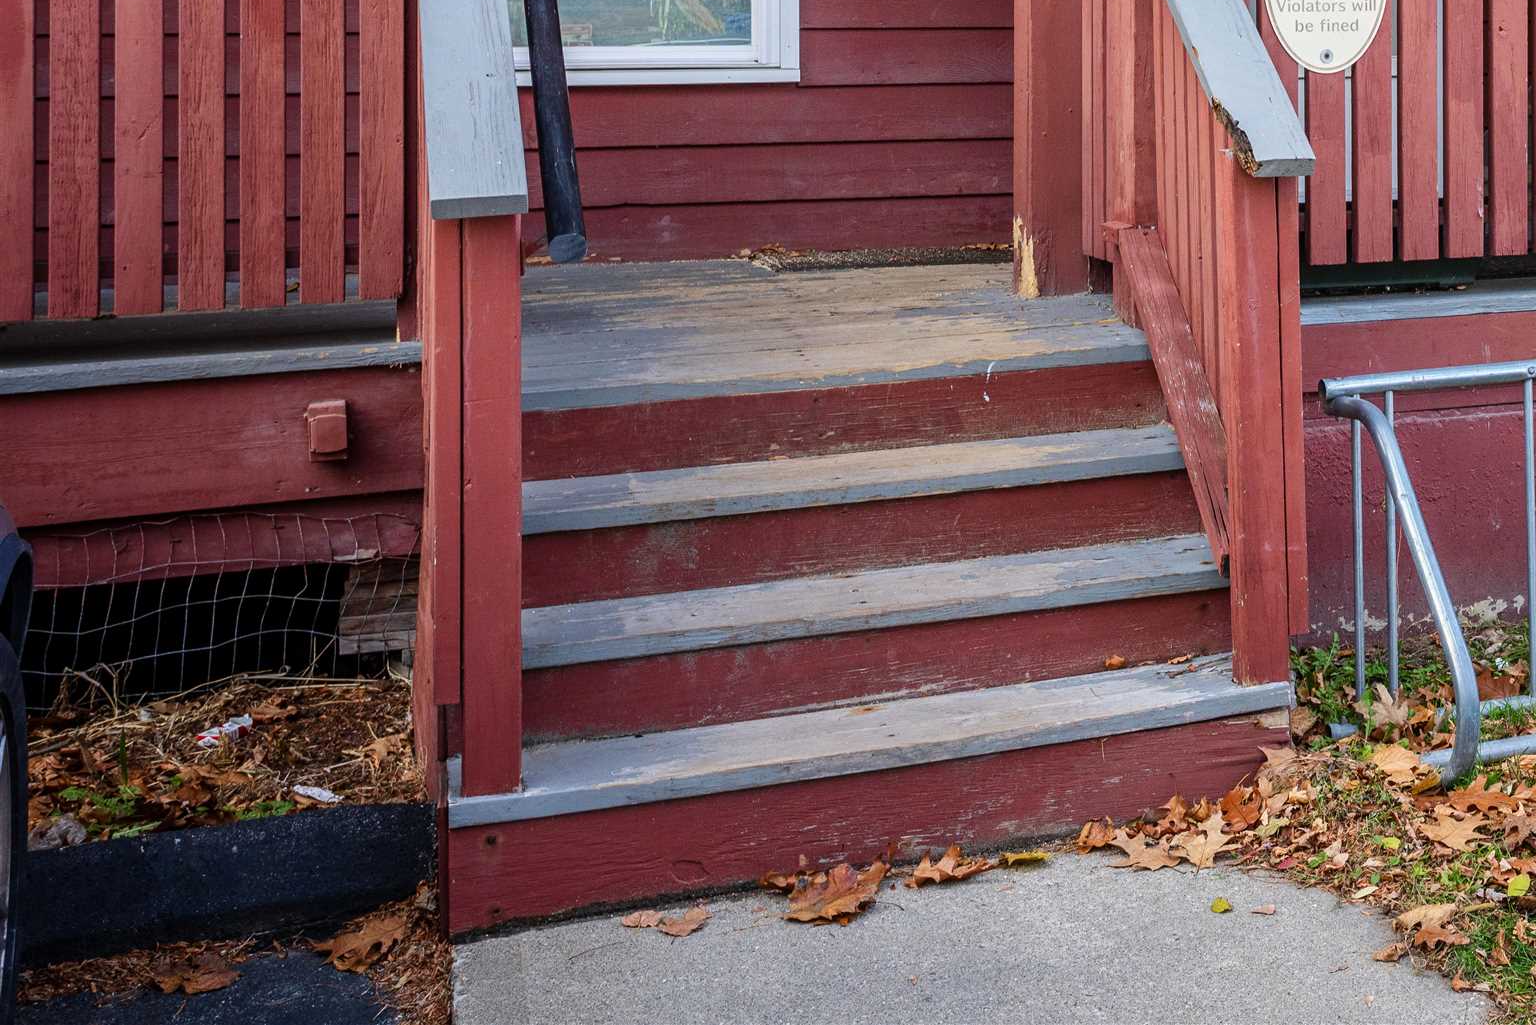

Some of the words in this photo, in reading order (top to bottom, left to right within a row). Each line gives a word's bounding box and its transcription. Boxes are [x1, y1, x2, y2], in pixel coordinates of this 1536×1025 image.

[1276, 0, 1346, 13] Violators
[1351, 0, 1376, 12] will
[1295, 19, 1314, 33] be
[1319, 19, 1359, 32] fined
